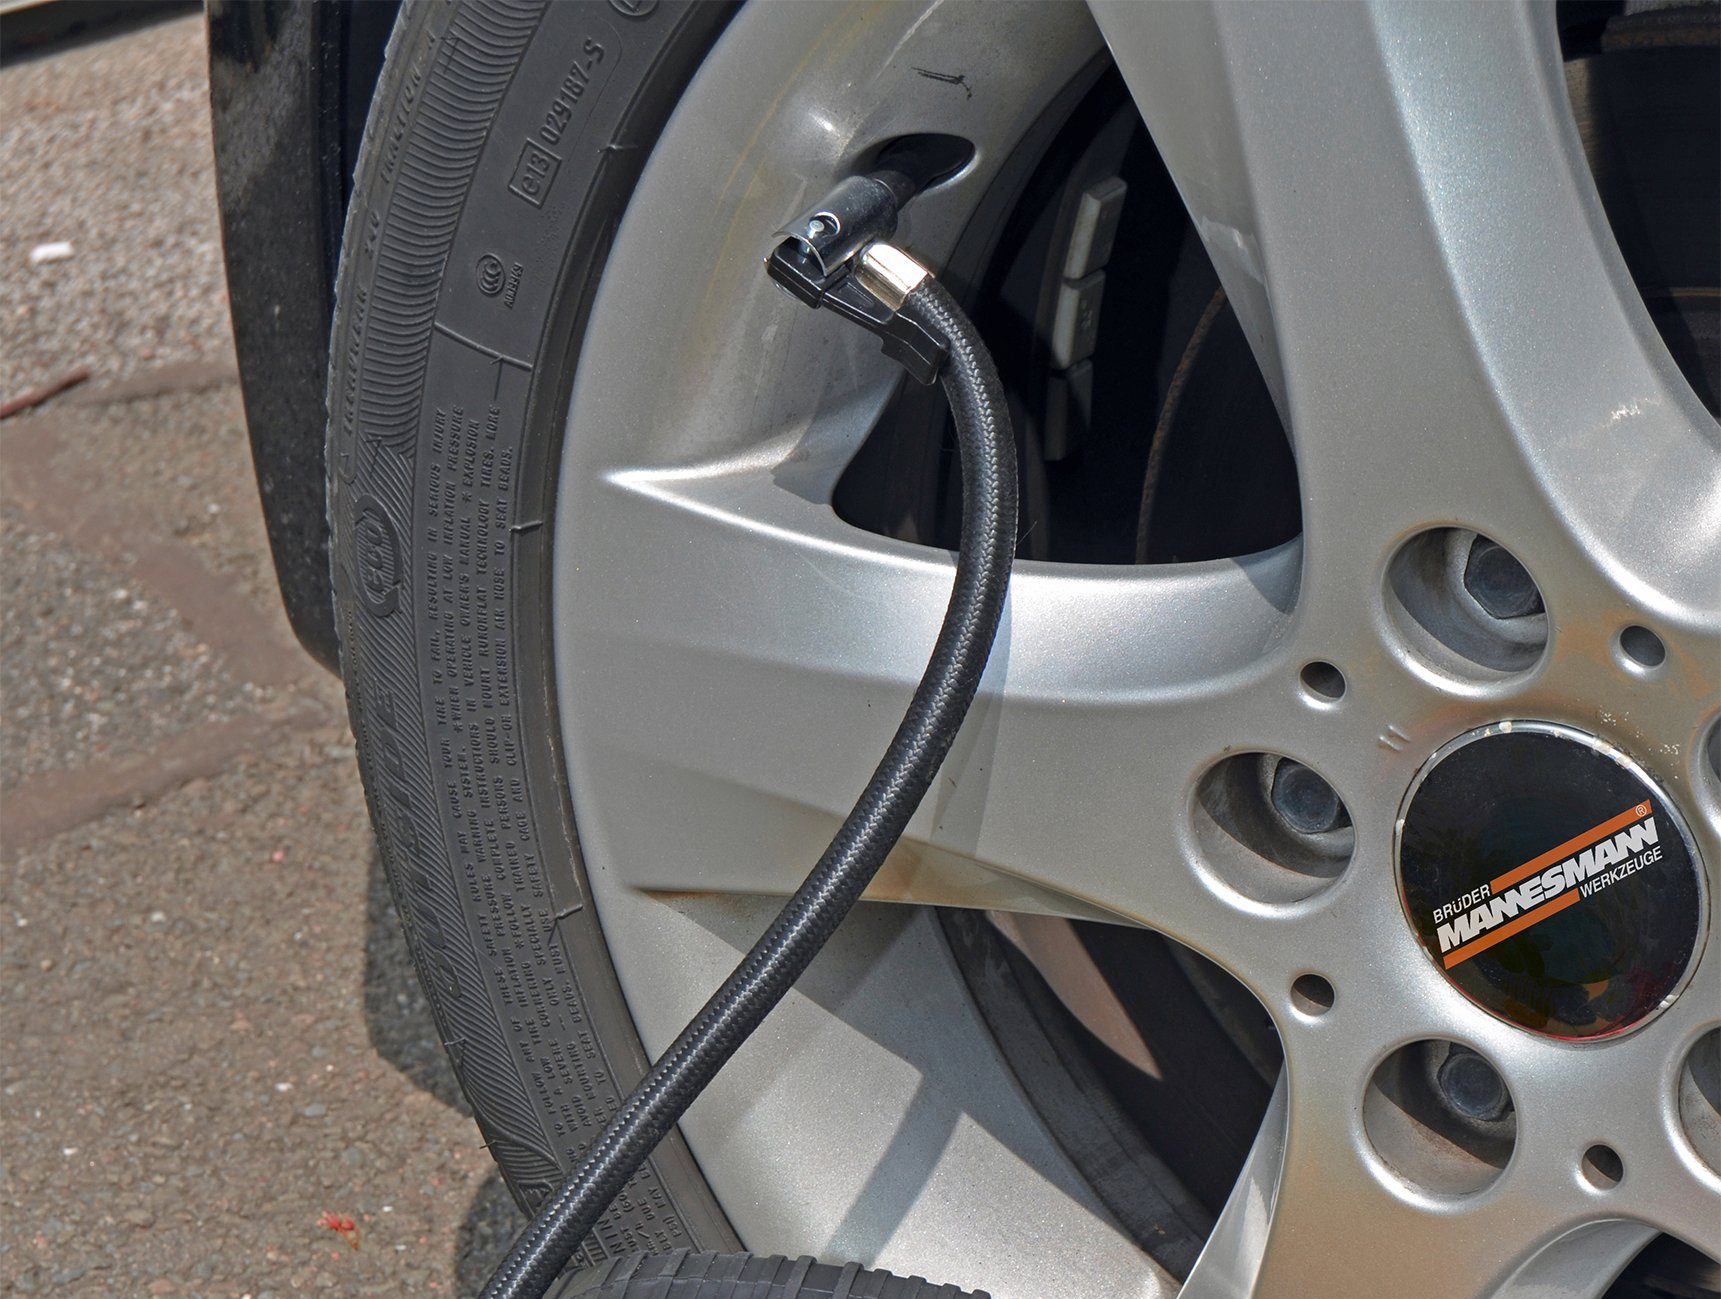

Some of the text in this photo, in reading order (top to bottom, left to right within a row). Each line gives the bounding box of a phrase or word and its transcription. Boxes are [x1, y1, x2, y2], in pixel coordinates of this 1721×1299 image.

[539, 37, 605, 147] 029187-S
[432, 408, 446, 454] INJURY
[447, 405, 463, 471] PRESSURE
[428, 464, 440, 517] SERIOUS
[427, 528, 437, 542] IN
[443, 482, 455, 545] INFLATION
[459, 517, 471, 565] MANUAL
[426, 553, 438, 620] RESULTING
[443, 556, 452, 579] LOW
[442, 587, 453, 603] AT
[458, 574, 470, 626] OWNER'S
[443, 612, 457, 678] OPERATING
[460, 635, 475, 686] VEHICLE
[431, 670, 442, 684] TO
[434, 697, 446, 725] TIRE
[466, 699, 476, 711] IN
[440, 738, 452, 768] YOUR
[457, 746, 473, 798] SYSTEM.
[468, 723, 491, 809] INSTRUCTIONS
[476, 405, 596, 1099] MOUNTING ONLY SPECIALLY TRAINED PERSONS SHOULD MOUNT RUNONFLAT TECHNOLOGY TIRES. MORE
[494, 446, 607, 1085] TO SEAT BEADS. MUST USE SAFETY CAGE AND CLIP-ON EXTENSION AIR HOSE TO SEAT BEADS.
[446, 781, 462, 819] CAUSE
[456, 832, 470, 854] MAY
[466, 810, 486, 862] WARNING
[484, 819, 506, 880] COMPLETE
[464, 863, 482, 902] RULES
[1436, 816, 1660, 953] MANNESMANN
[1579, 846, 1663, 899] WERKZEUGE
[480, 874, 505, 937] PRESSURE
[1432, 883, 1491, 924] BRÜDER
[476, 914, 497, 957] SAFETY
[494, 968, 512, 1005] THESE
[501, 947, 529, 1008] INFLATION
[521, 962, 550, 1027] CORNERING
[510, 1016, 522, 1032] OF
[524, 1017, 542, 1045] TIRE
[540, 1057, 556, 1079] LOW
[549, 1039, 574, 1084] SEVERE
[532, 1072, 557, 1114] FOLLOW
[573, 1095, 591, 1127] AVOID
[562, 1104, 578, 1132] WITH
[637, 1197, 656, 1221] DUE
